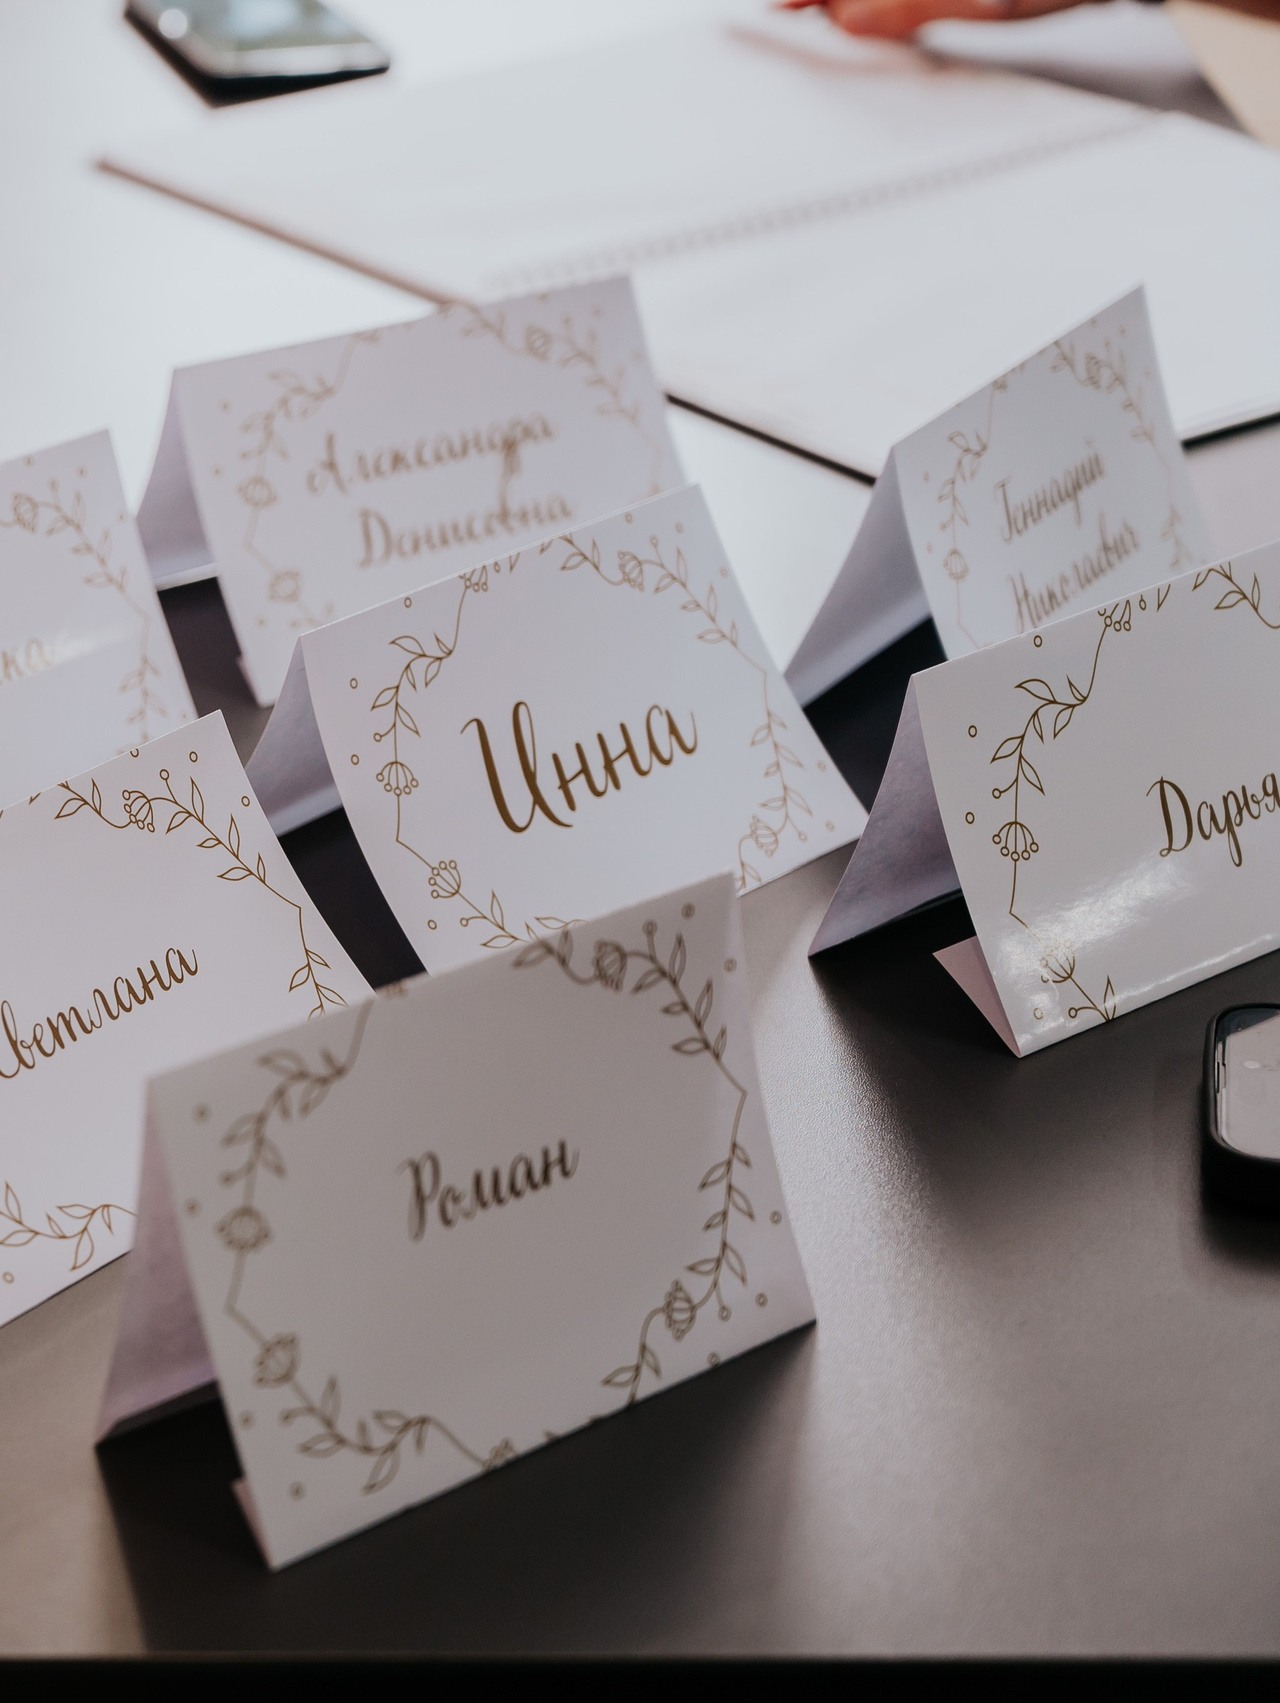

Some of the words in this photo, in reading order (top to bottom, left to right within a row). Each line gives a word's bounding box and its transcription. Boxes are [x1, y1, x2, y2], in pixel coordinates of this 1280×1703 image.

[306, 414, 555, 494] Александра
[994, 435, 1105, 544] Геннадий
[459, 701, 698, 833] Инна
[1146, 772, 1280, 867] Дарья
[396, 1138, 580, 1243] Роман
